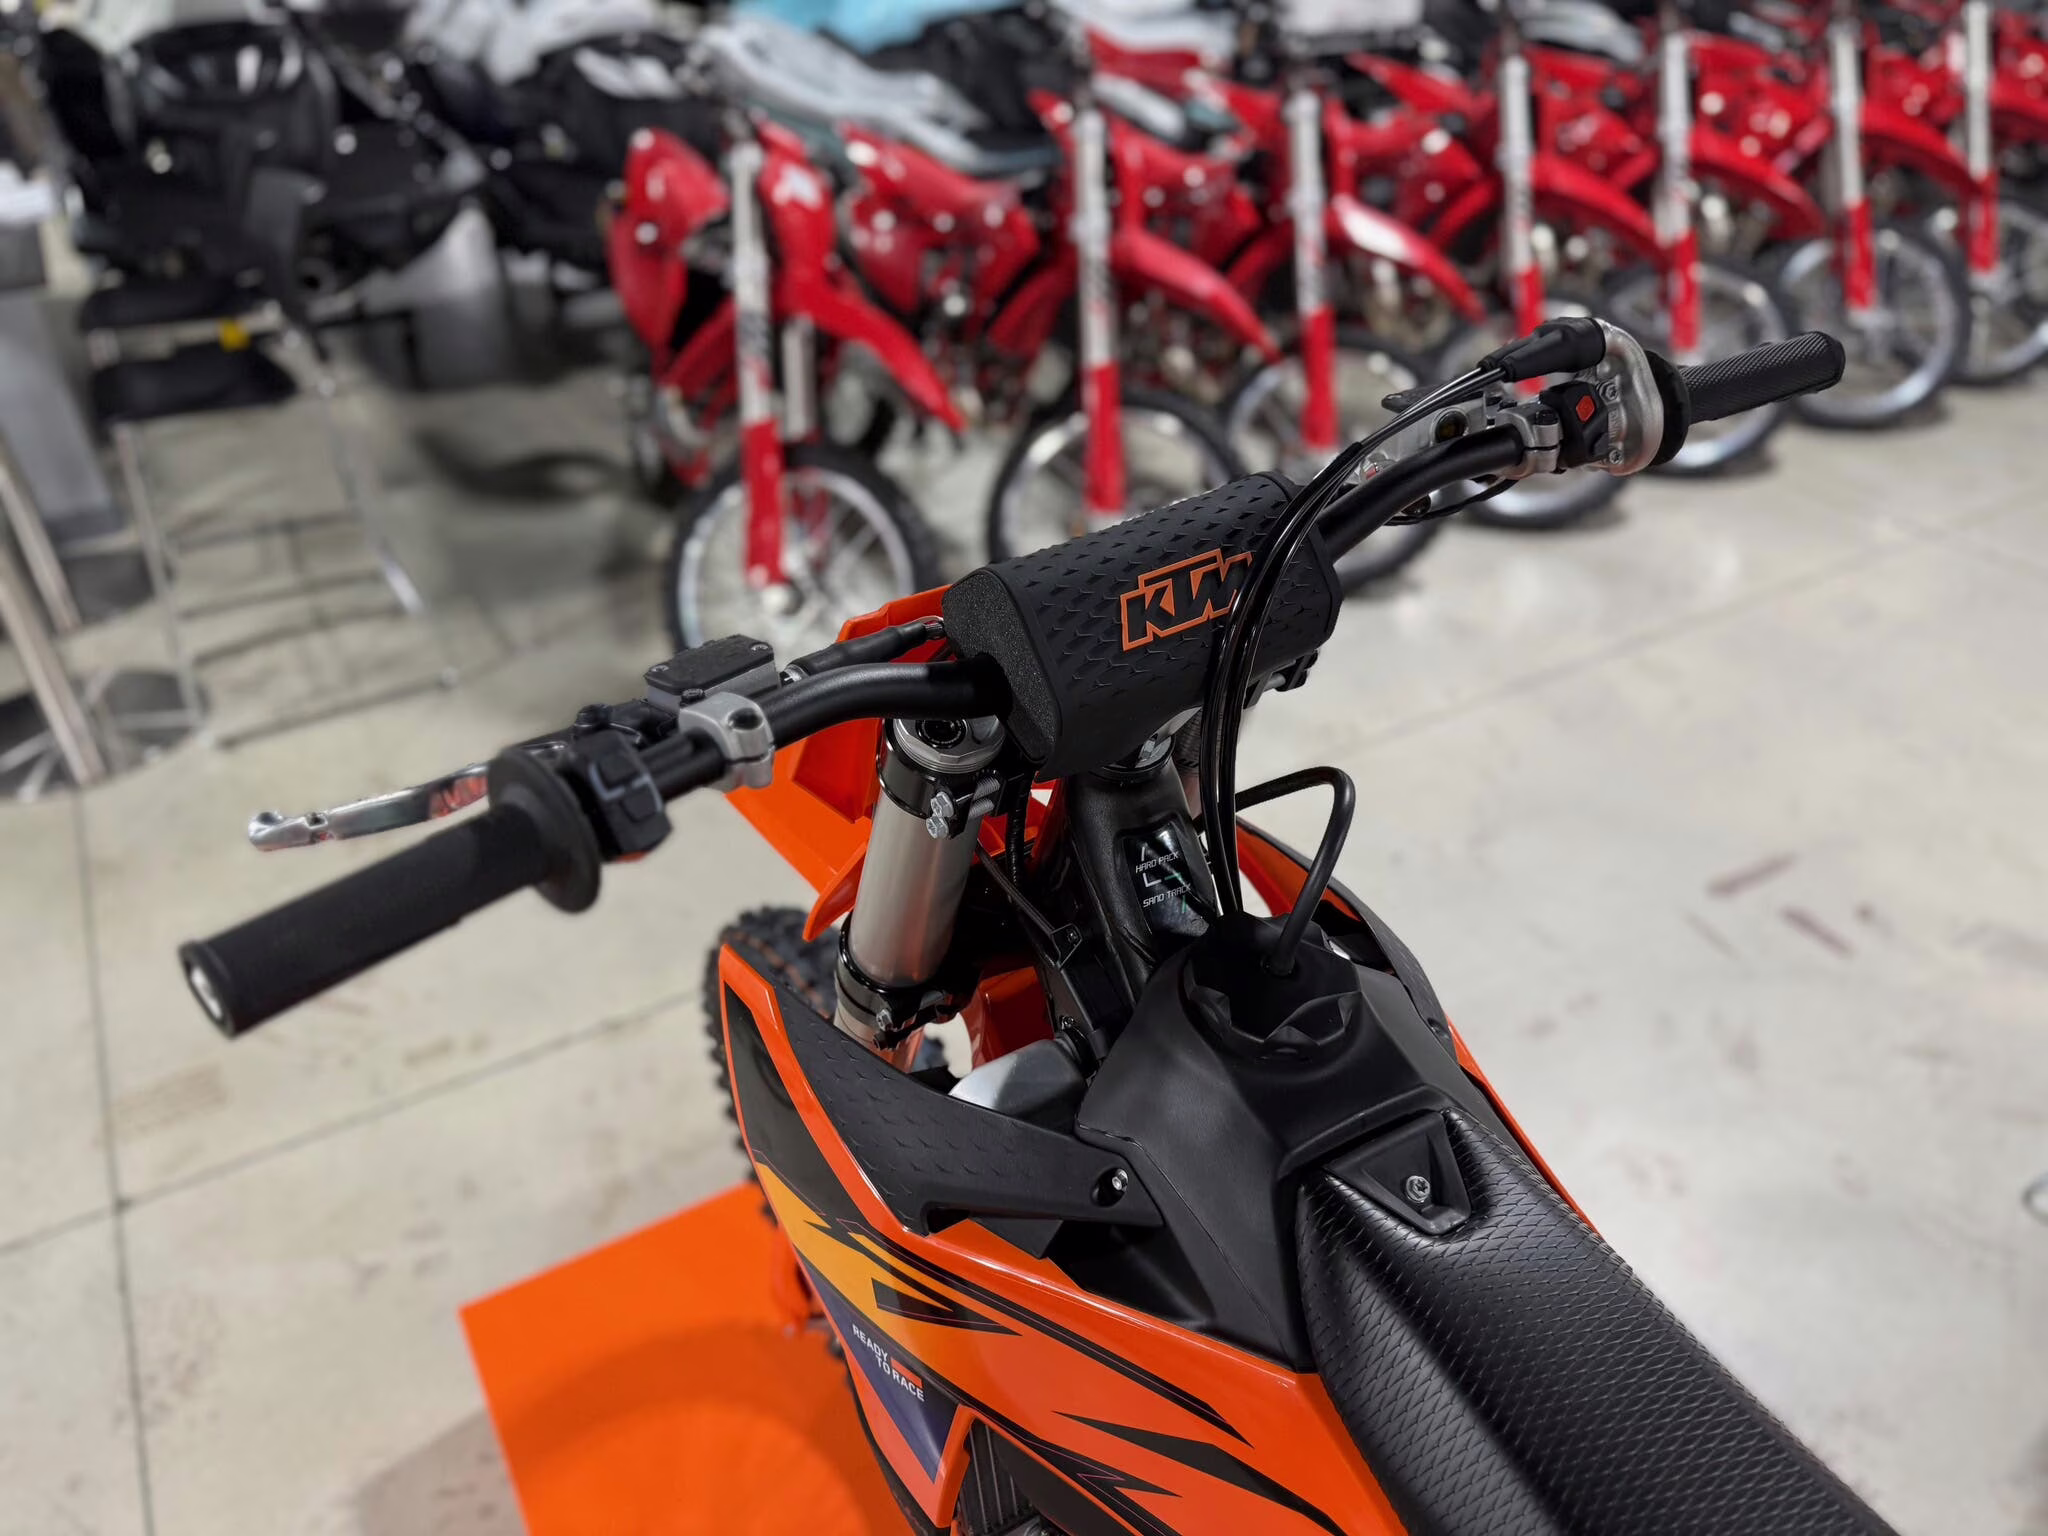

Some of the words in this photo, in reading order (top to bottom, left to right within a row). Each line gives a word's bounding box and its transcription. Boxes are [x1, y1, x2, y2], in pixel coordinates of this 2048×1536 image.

[1135, 859, 1158, 874] HARD
[1158, 851, 1179, 865] PACK
[1143, 893, 1165, 908] SAND
[1166, 883, 1191, 899] TRACK
[852, 1323, 888, 1361] READY
[875, 1354, 890, 1375] TO
[892, 1369, 925, 1402] RACE
